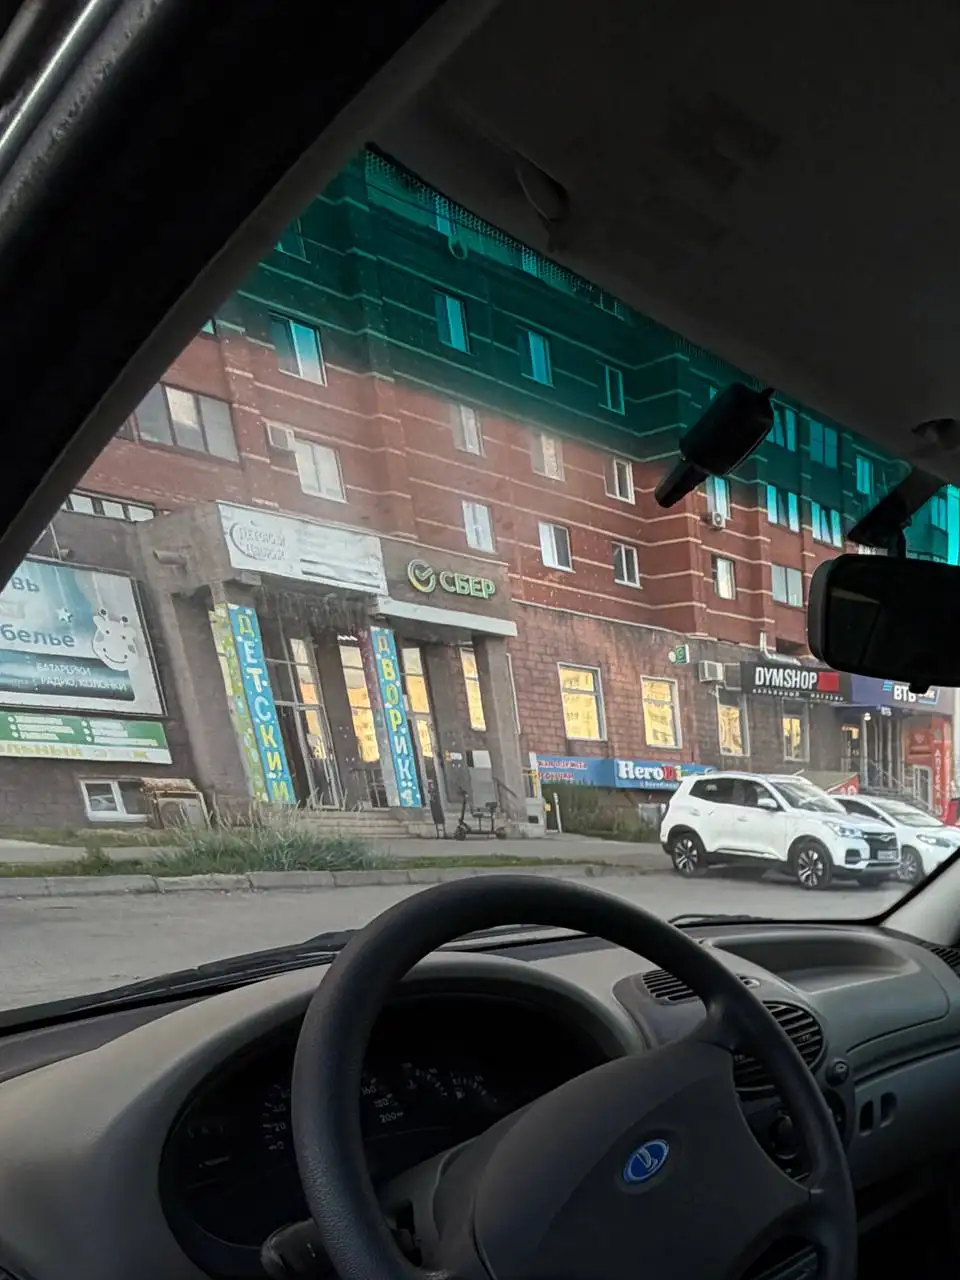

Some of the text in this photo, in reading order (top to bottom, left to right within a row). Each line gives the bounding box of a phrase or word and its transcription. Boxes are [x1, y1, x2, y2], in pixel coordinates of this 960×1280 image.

[11, 576, 40, 592] вь
[440, 570, 496, 599] СБЕР
[0, 623, 75, 648] белье
[755, 666, 818, 690] DYMSHOP
[237, 614, 290, 803] ДЕТСКИЙ
[376, 635, 412, 780] ДВОРИК
[617, 760, 682, 781] HeroDi
